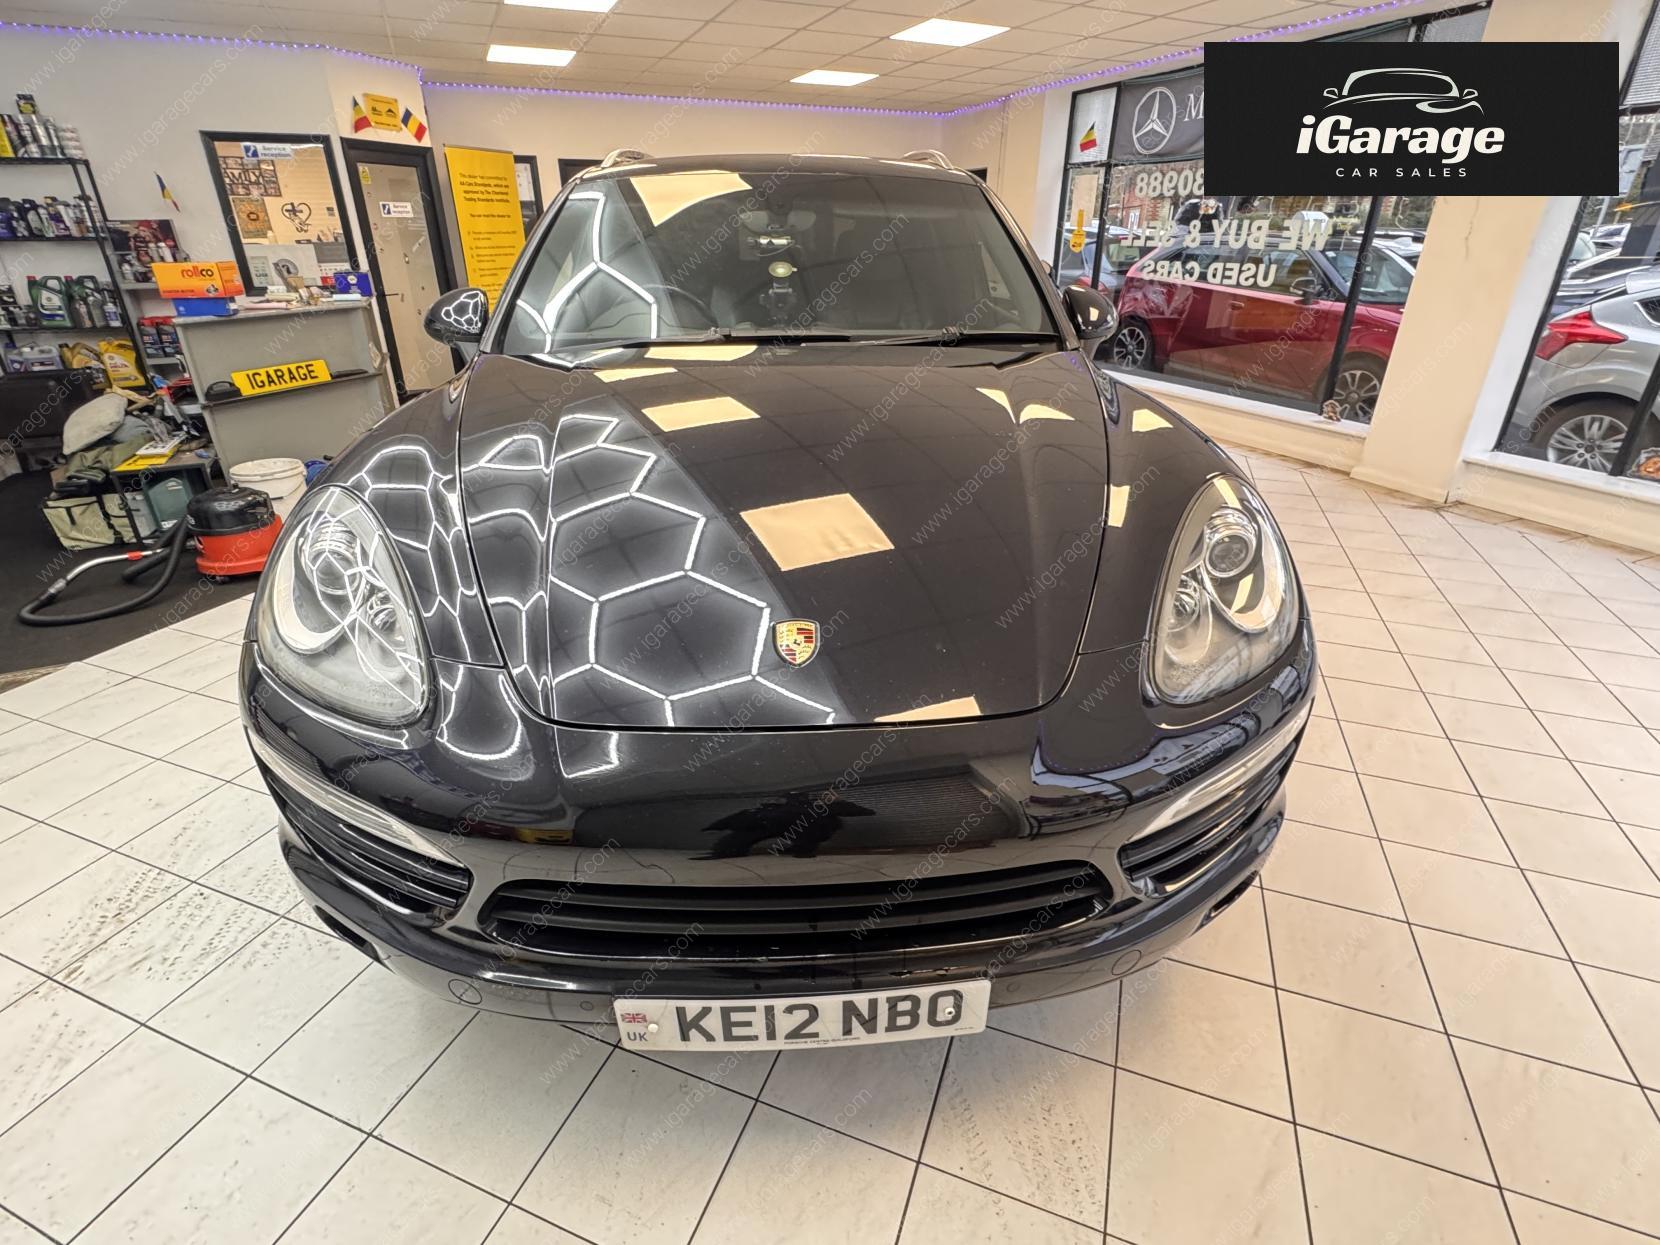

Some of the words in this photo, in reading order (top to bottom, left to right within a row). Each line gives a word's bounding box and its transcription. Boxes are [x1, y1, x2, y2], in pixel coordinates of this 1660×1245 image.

[223, 169, 264, 185] AMILY
[181, 266, 214, 278] rollco
[246, 364, 318, 390] IGARAGE
[676, 1003, 819, 1042] KE12
[842, 989, 964, 1036] NBO
[627, 1032, 648, 1041] UK
